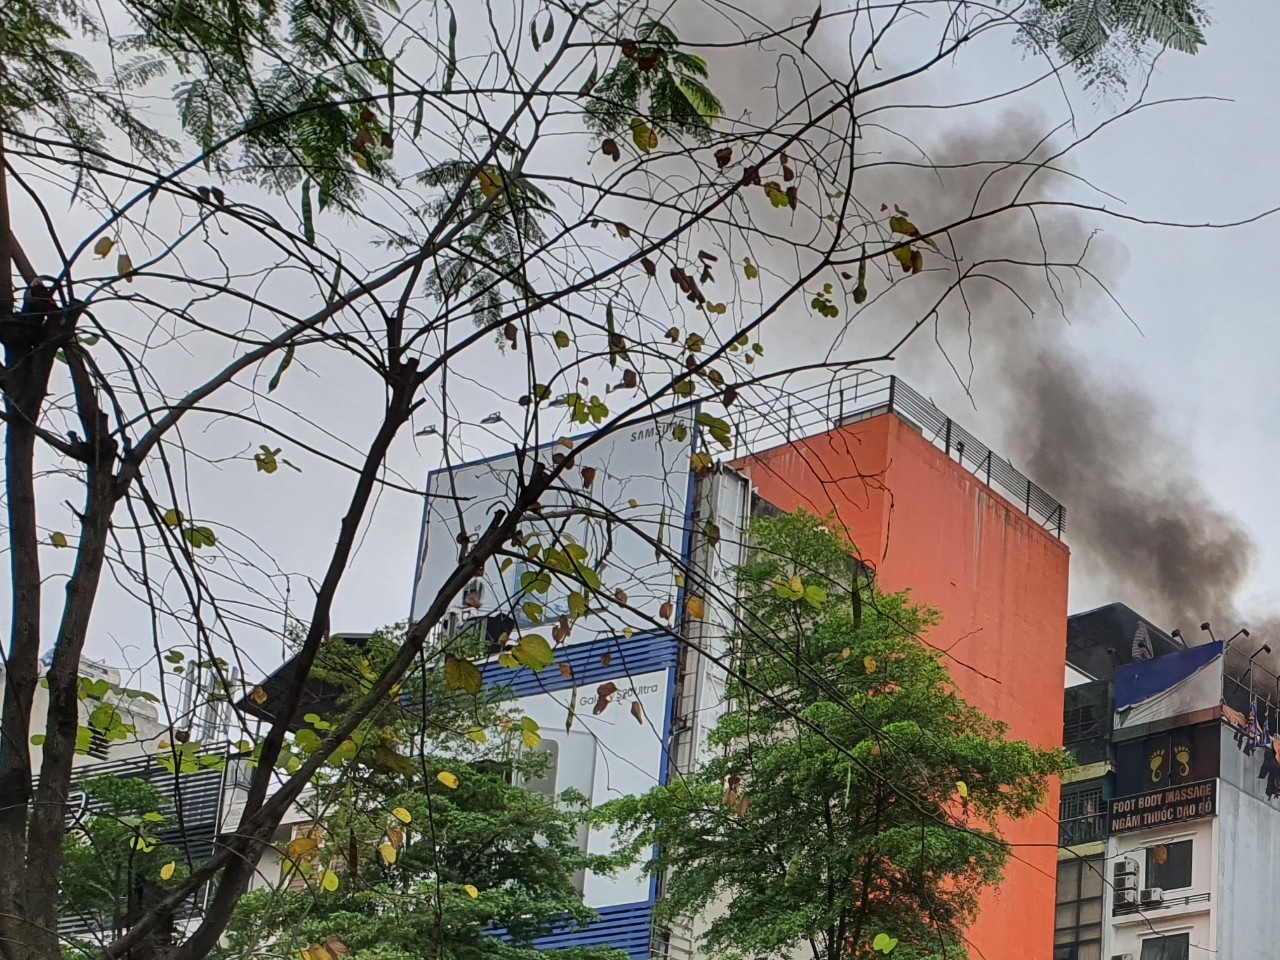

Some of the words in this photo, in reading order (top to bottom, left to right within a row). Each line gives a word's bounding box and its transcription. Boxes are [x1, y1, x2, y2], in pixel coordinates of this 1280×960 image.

[580, 693, 614, 707] Galy
[1113, 799, 1136, 814] FOOT
[1138, 791, 1163, 809] BODY
[1165, 783, 1212, 804] MASSAGE
[1112, 812, 1141, 831] NGÂM
[1143, 805, 1174, 825] THUỐC
[1176, 804, 1196, 818] DAO
